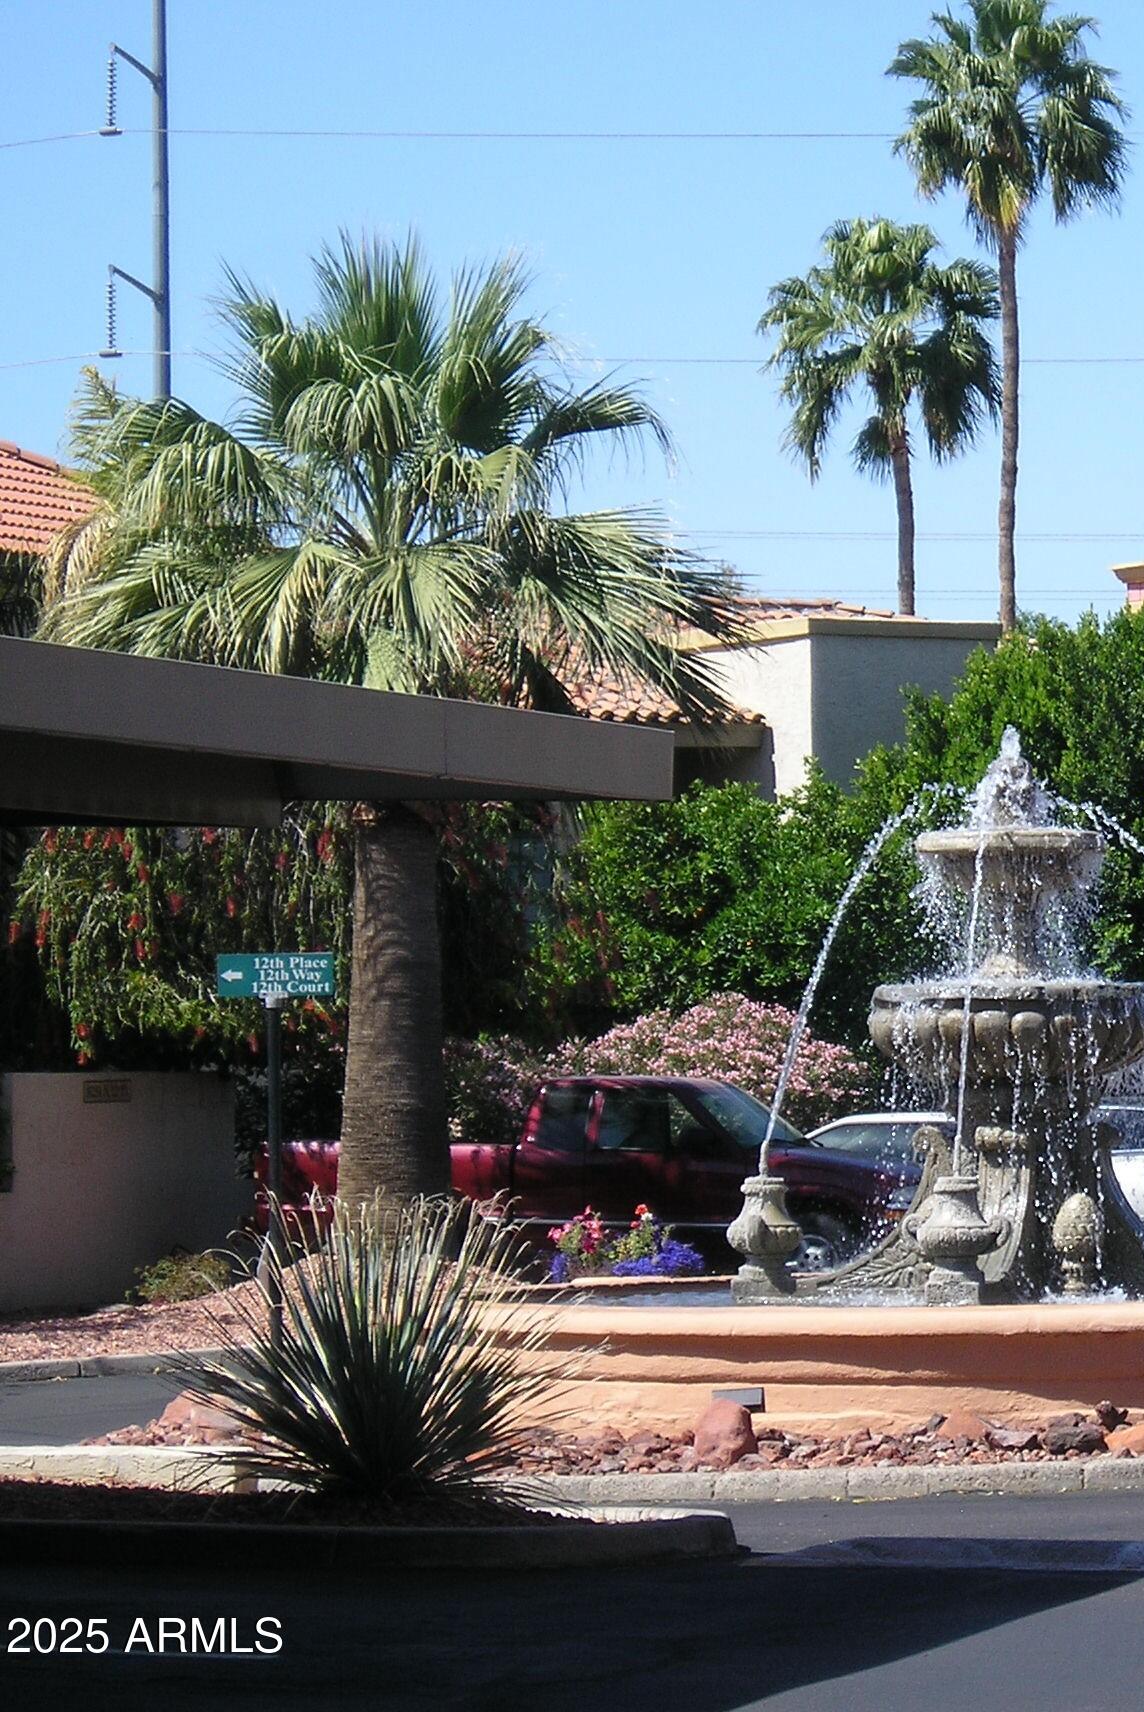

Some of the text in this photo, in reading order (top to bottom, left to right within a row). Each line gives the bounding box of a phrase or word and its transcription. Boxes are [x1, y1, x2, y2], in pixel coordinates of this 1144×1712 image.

[254, 956, 328, 969] 12th Place
[259, 968, 321, 982] 12th Way
[252, 980, 330, 993] 12th Court
